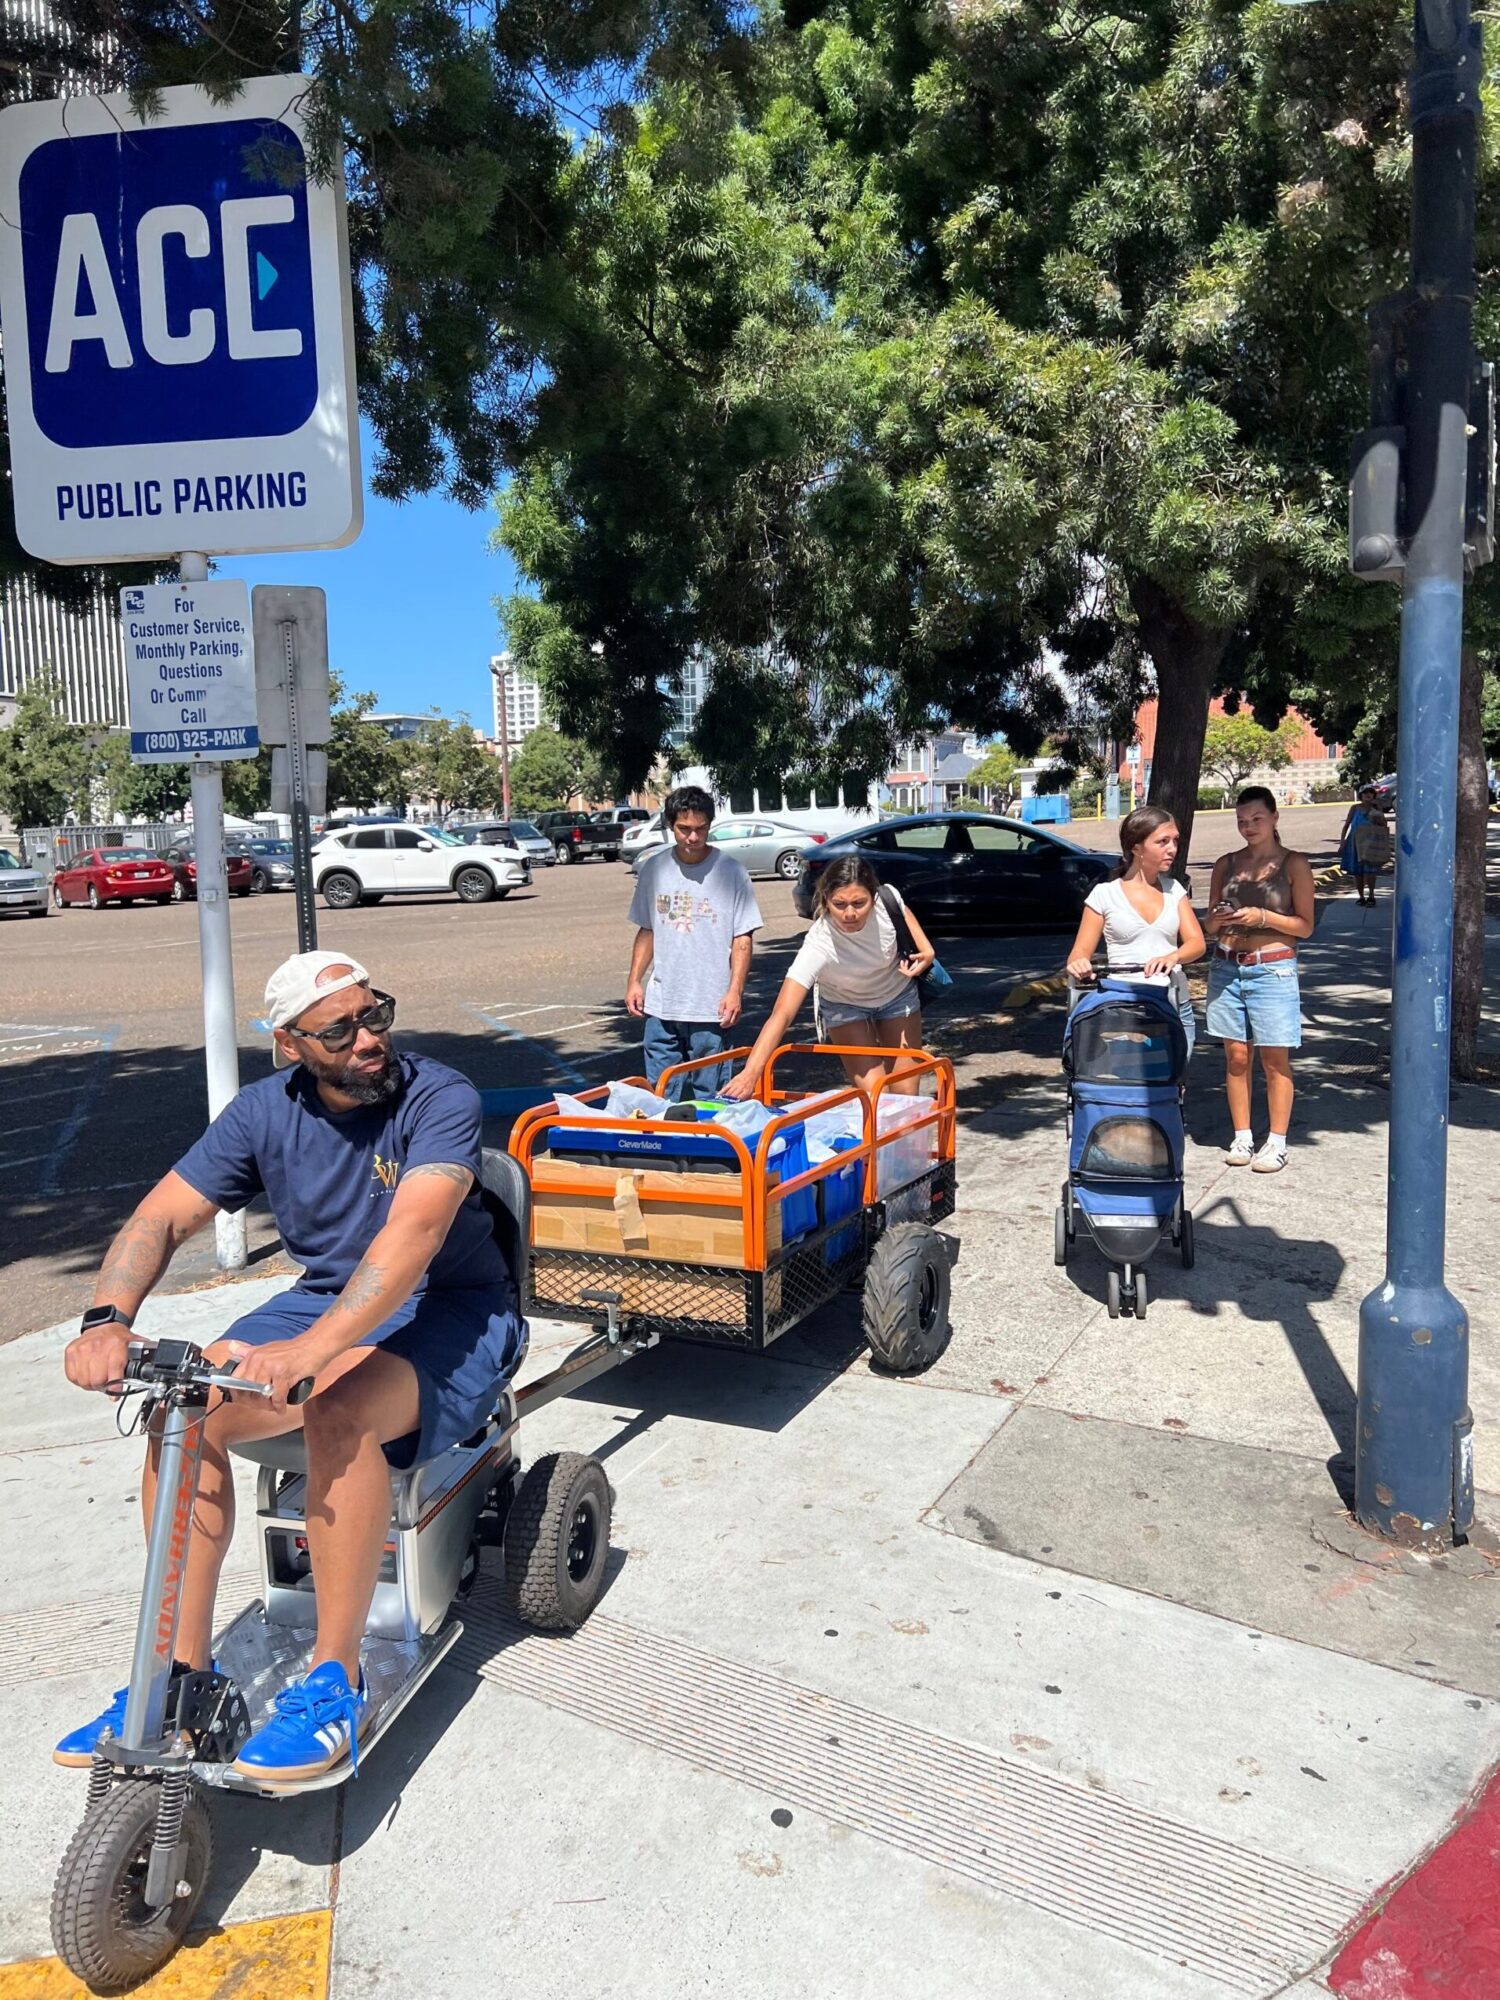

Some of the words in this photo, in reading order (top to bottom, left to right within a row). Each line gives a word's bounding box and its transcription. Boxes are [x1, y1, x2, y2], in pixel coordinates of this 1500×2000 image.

[45, 194, 303, 373] ACE
[56, 480, 162, 521] PUBLIC
[173, 471, 307, 514] PARKING
[174, 598, 195, 613] For
[130, 622, 189, 638] Customer
[193, 618, 245, 635] Service,
[136, 642, 185, 660] Monthly
[189, 640, 243, 657] Parking,
[159, 662, 223, 681] Questions
[150, 688, 164, 704] Or
[181, 708, 207, 724] Call
[145, 732, 180, 752] (800)
[182, 728, 247, 748] 925-PARK
[617, 1139, 663, 1150] CleverMade
